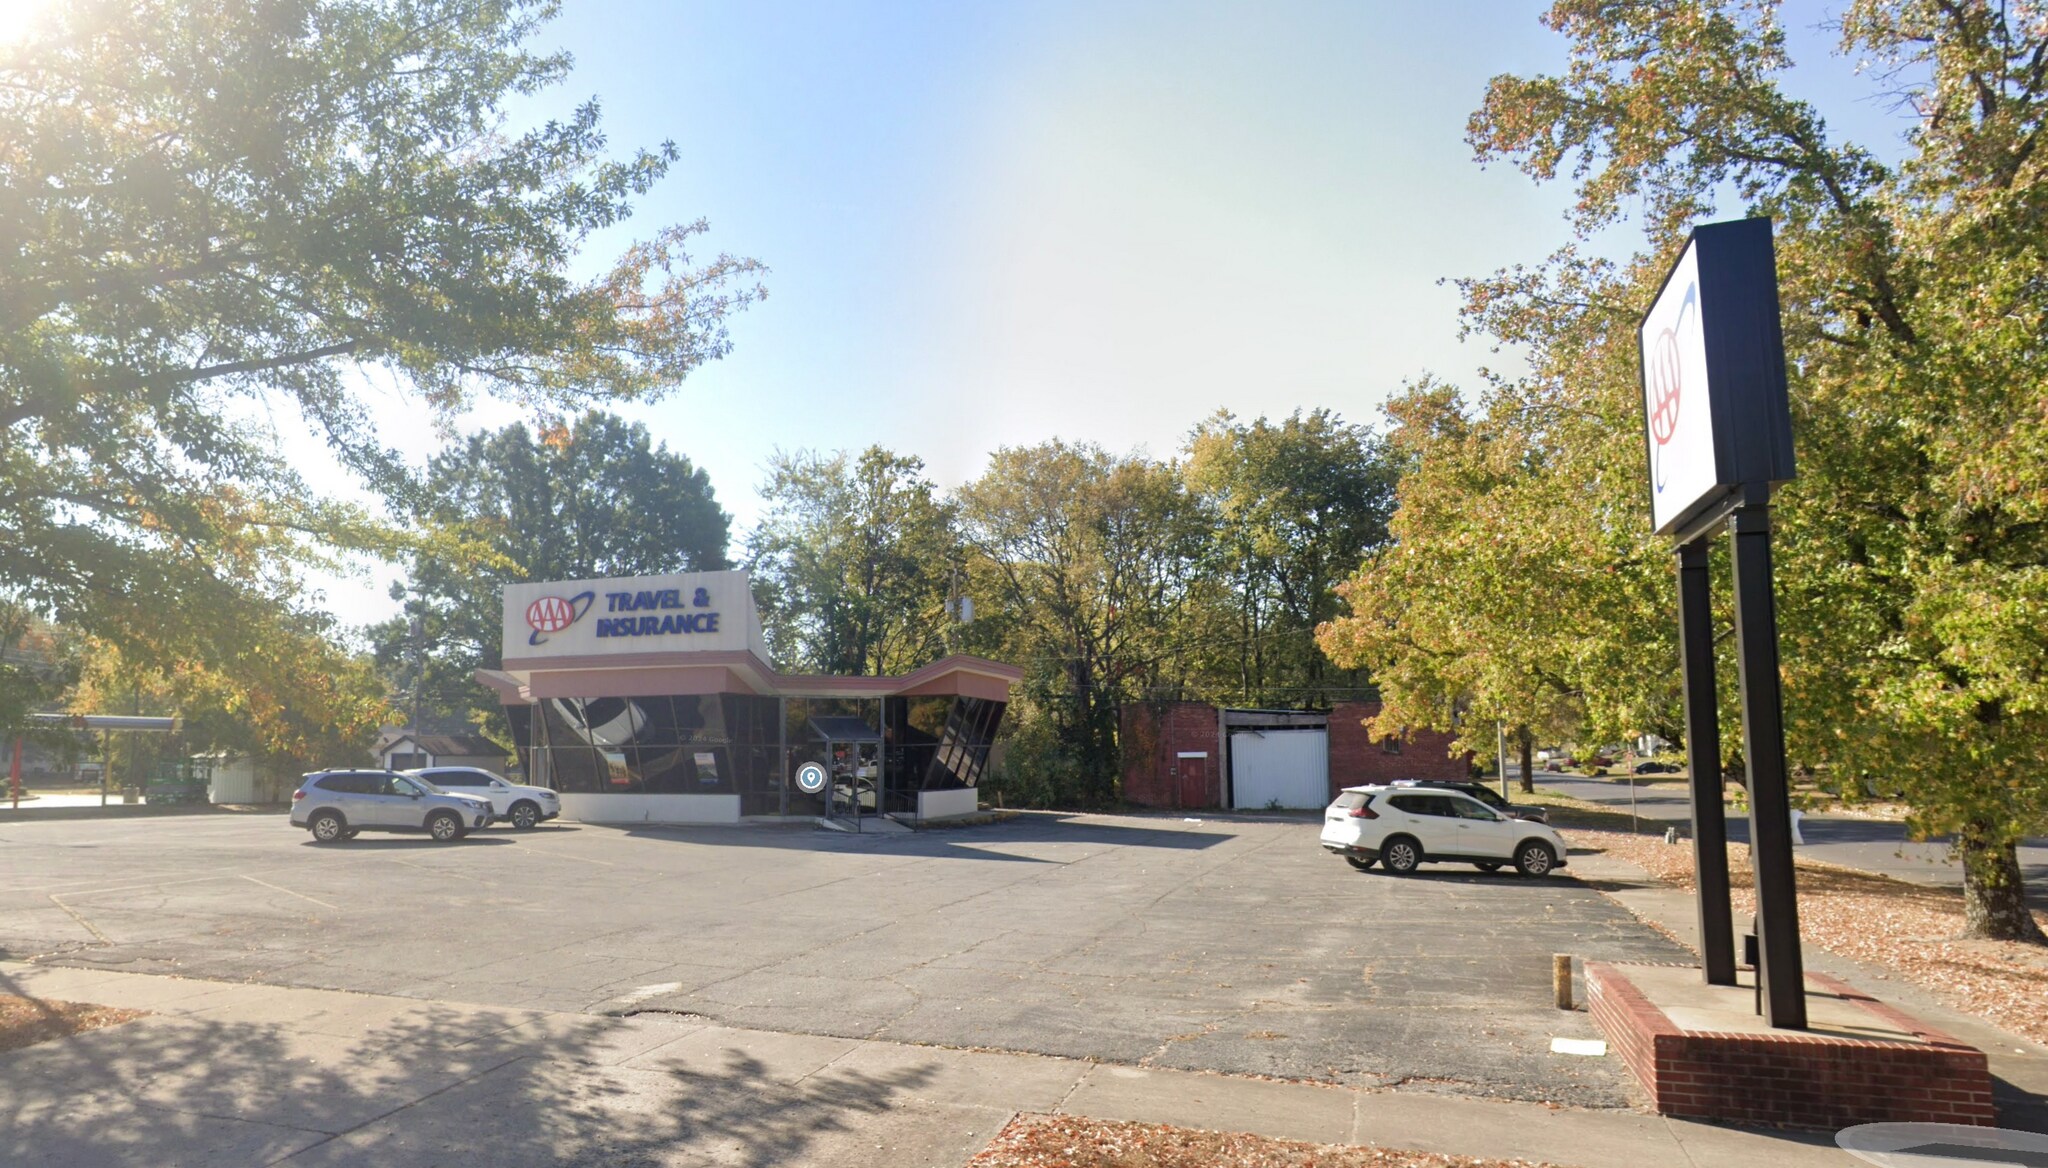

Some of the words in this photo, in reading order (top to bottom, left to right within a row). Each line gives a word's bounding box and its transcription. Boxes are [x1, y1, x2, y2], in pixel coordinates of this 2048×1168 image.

[605, 589, 685, 612] TRAVEL
[693, 587, 710, 608] &
[529, 597, 572, 632] AAA
[596, 613, 720, 638] INSURANCE
